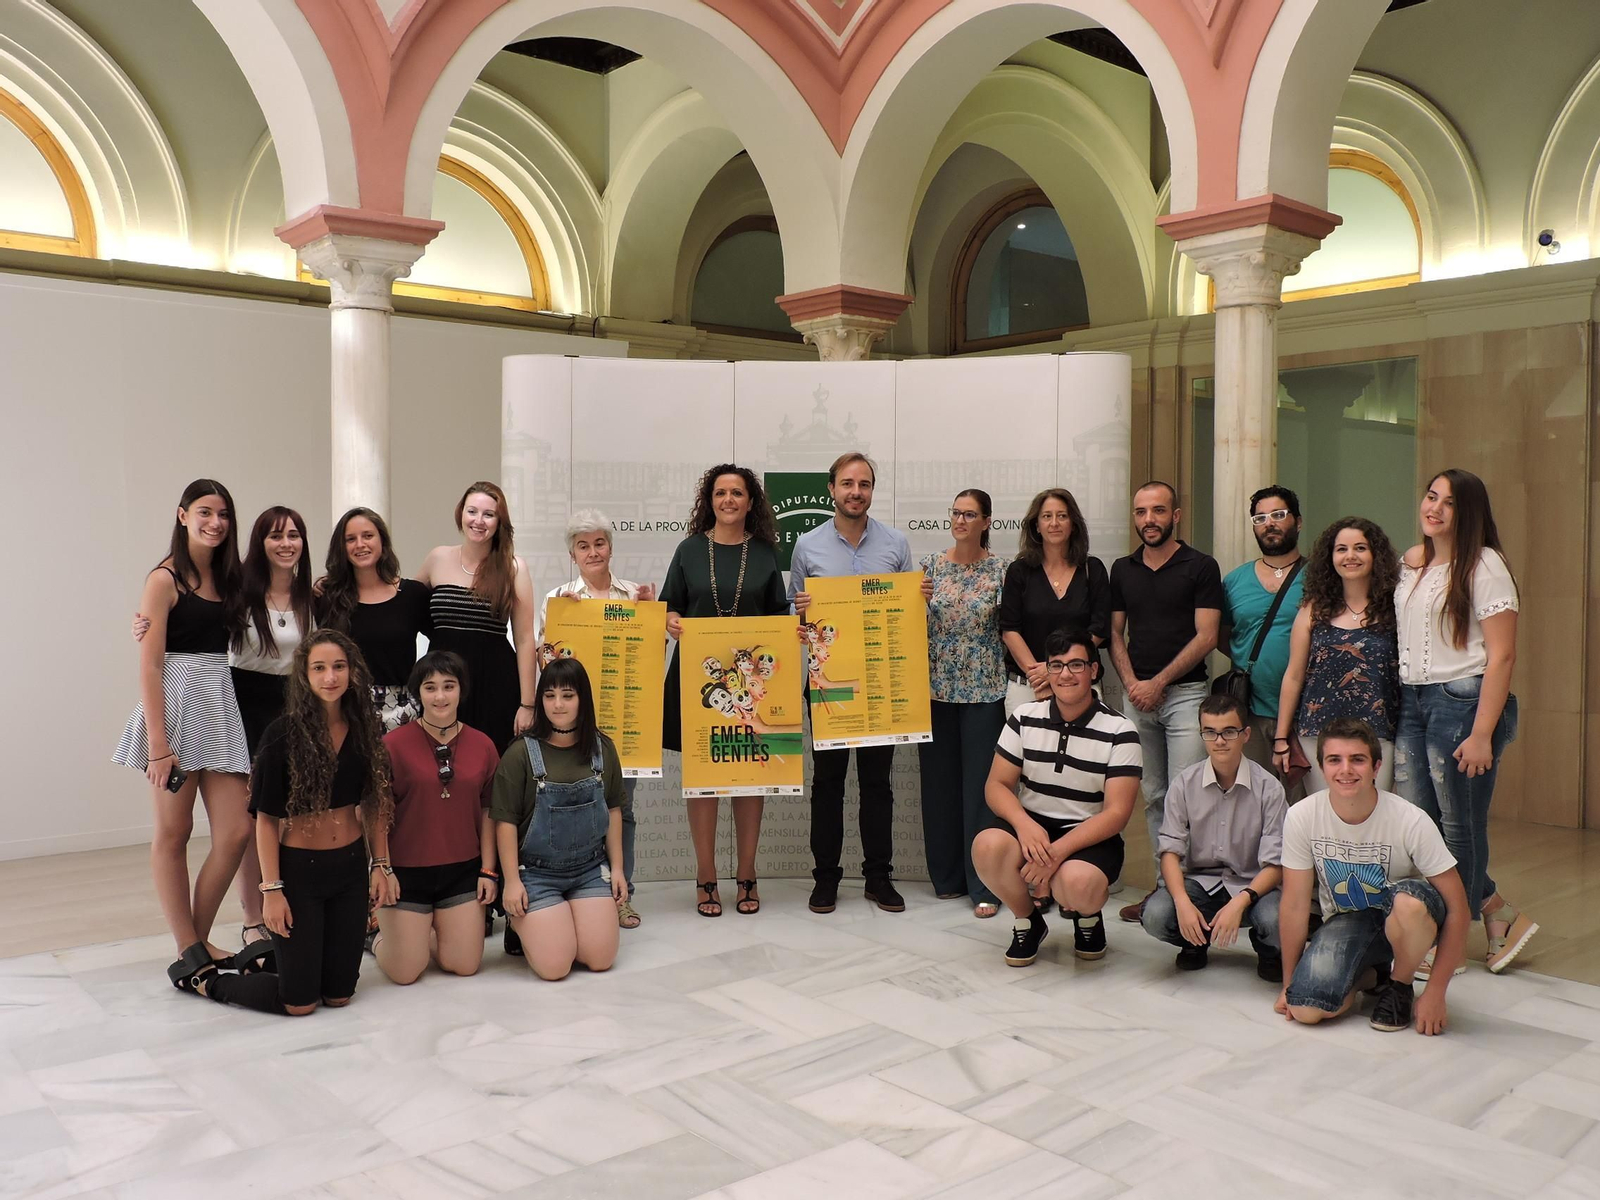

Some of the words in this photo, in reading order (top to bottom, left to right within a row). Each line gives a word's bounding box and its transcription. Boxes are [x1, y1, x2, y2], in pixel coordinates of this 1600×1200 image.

[772, 495, 836, 513] DIPUTACI
[620, 521, 635, 532] DE
[639, 521, 653, 532] LA
[655, 521, 690, 532] PROVI
[804, 518, 817, 526] DE
[908, 519, 940, 531] CASA
[861, 578, 880, 588] EMER
[861, 587, 888, 596] GENTES
[604, 603, 623, 613] EMER
[604, 612, 630, 622] GENTES
[711, 725, 754, 744] EMER
[711, 744, 770, 763] GENTES
[649, 782, 668, 792] DEL
[646, 799, 658, 809] LA
[654, 814, 674, 825] DEL
[782, 811, 795, 821] LA
[635, 832, 672, 843] RISCAL,
[760, 828, 810, 838] MENSILLA
[636, 849, 668, 859] ILLEJA
[672, 847, 691, 858] DEL
[655, 865, 678, 875] SAN
[766, 861, 810, 871] PUERTO
